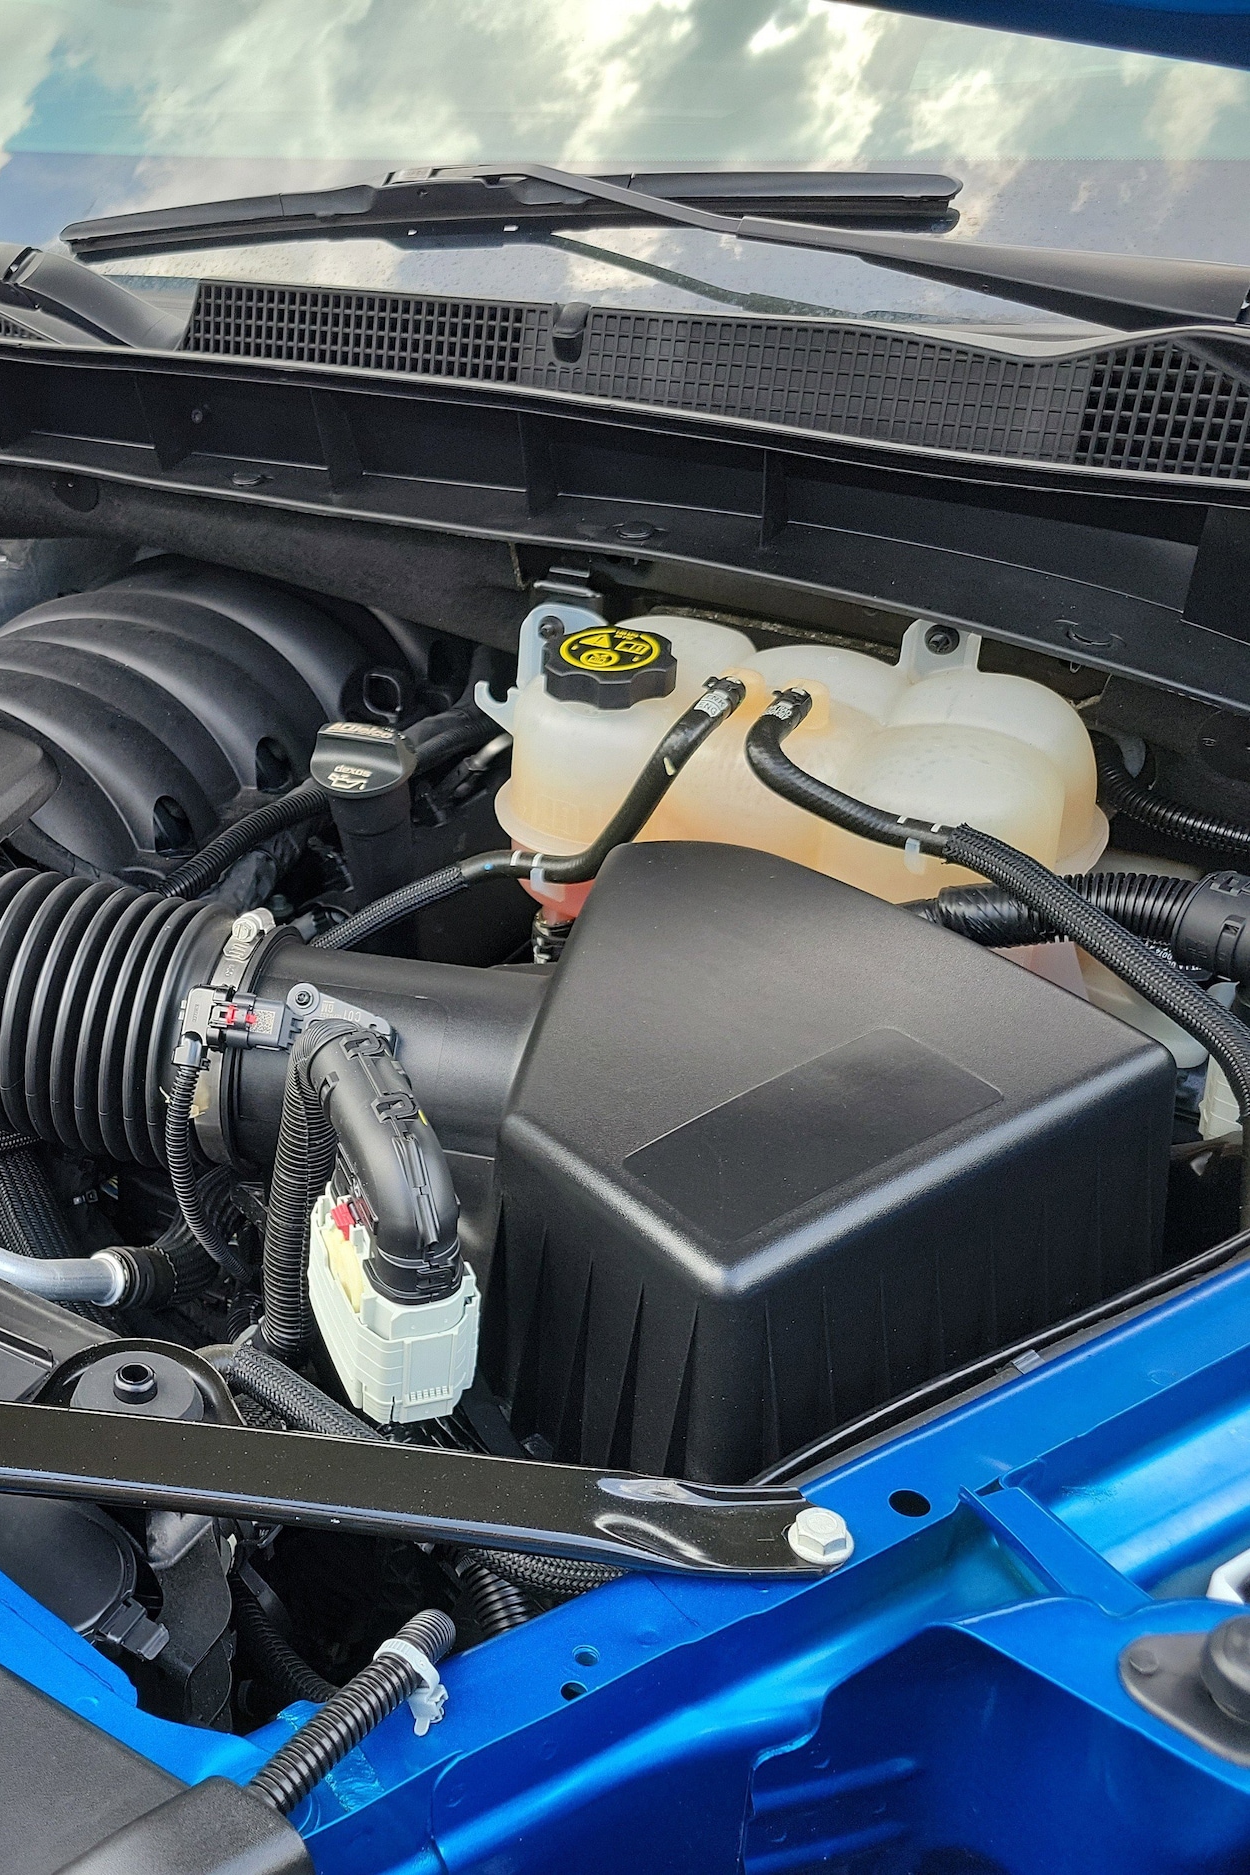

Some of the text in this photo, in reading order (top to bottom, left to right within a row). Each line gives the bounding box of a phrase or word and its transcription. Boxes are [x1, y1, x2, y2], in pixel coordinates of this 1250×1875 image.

[325, 722, 394, 739] ACDelco
[334, 764, 373, 778] dexos
[320, 1003, 335, 1014] GM
